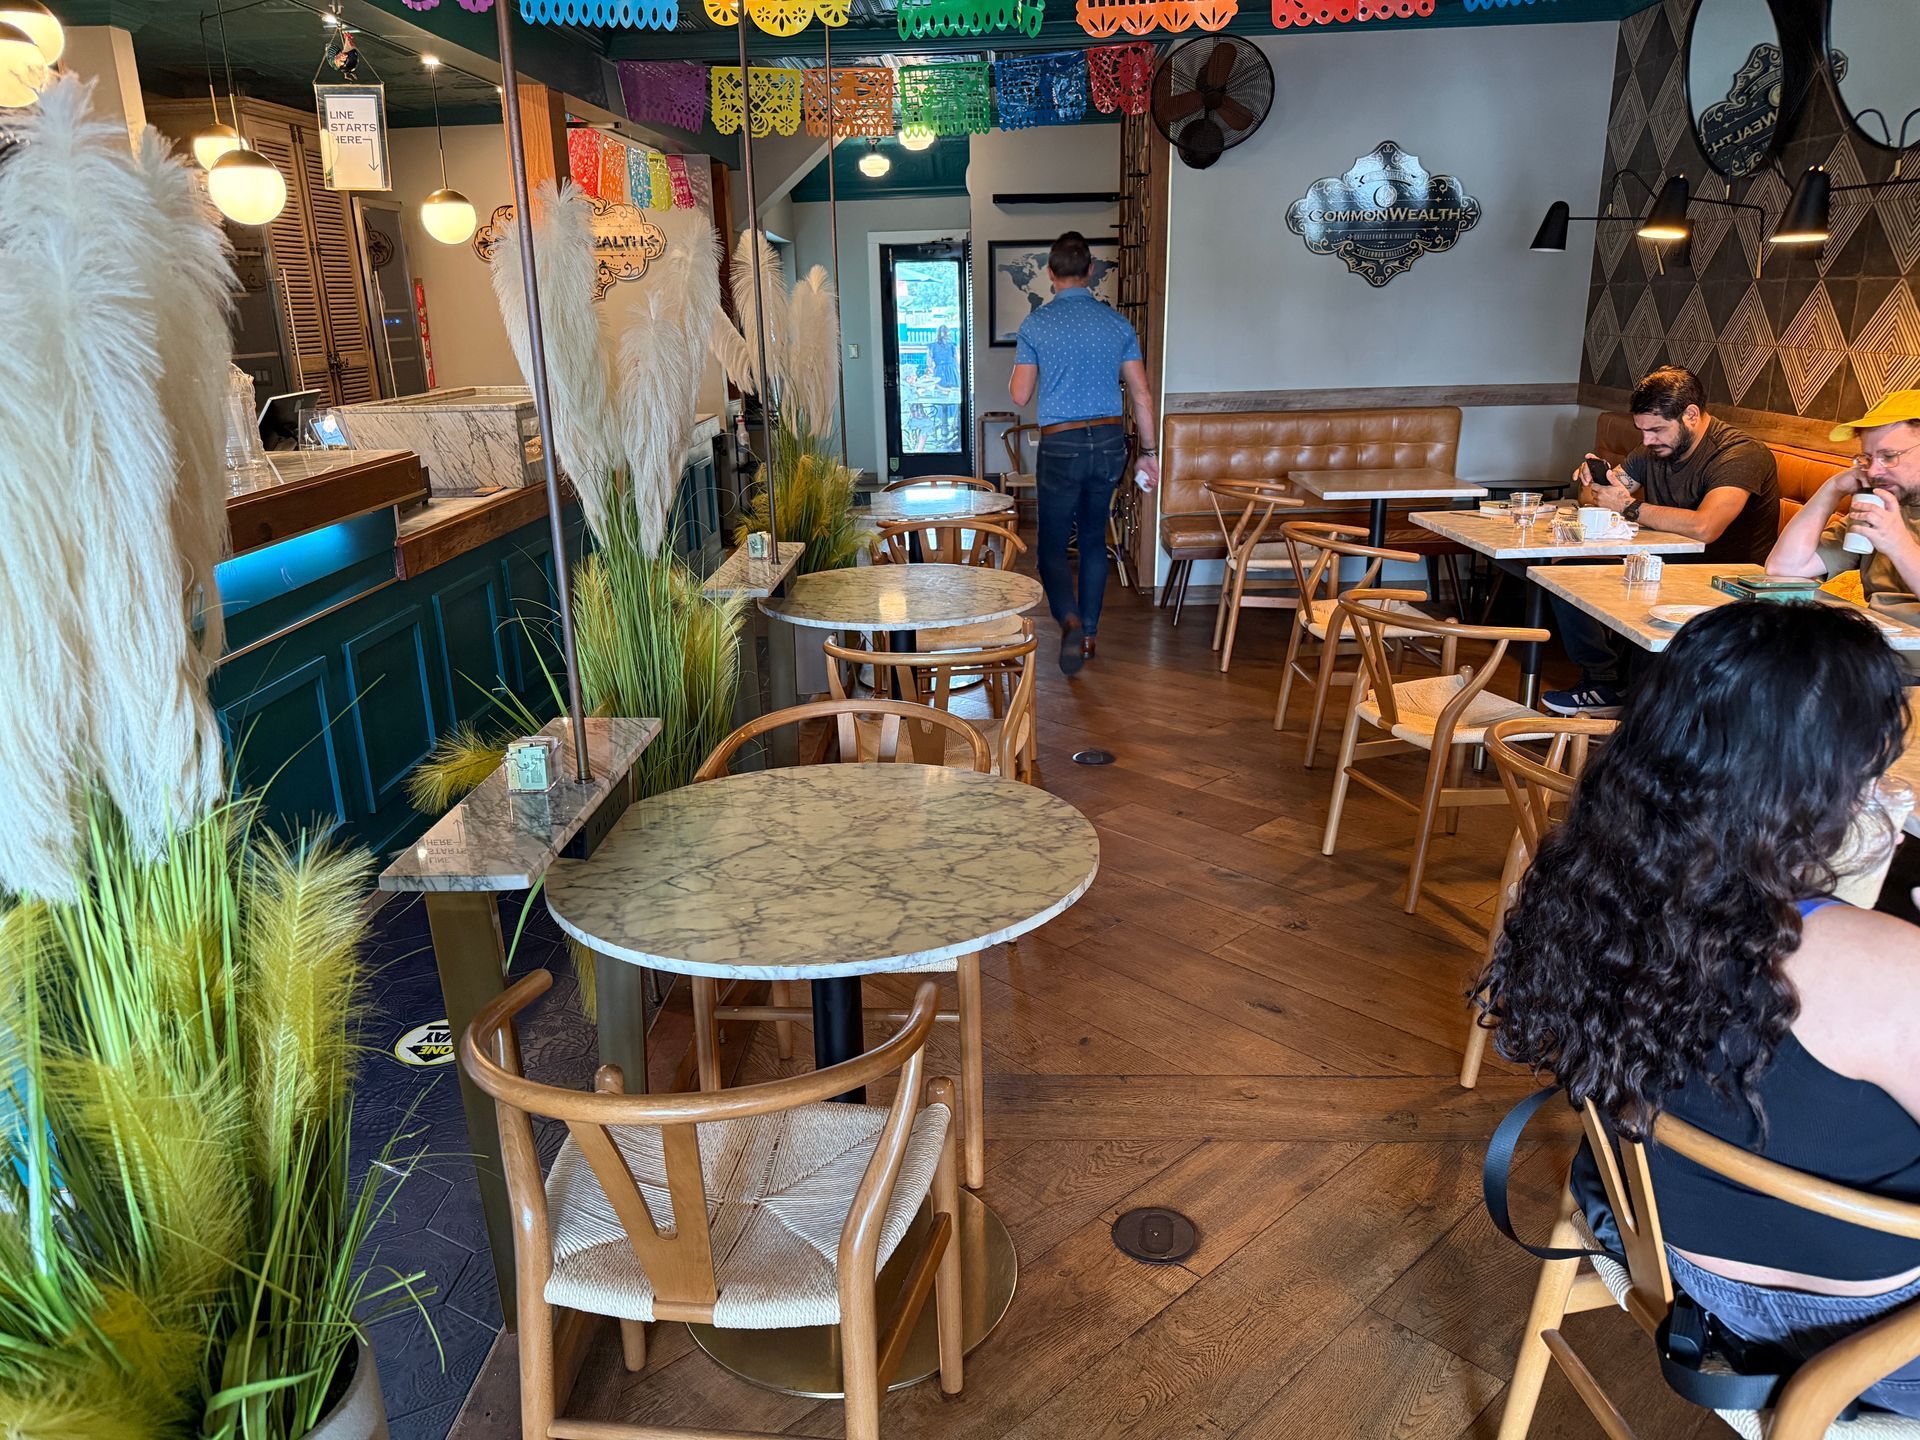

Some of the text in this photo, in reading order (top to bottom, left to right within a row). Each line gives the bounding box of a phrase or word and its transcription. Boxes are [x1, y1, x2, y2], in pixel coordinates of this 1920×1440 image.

[329, 111, 354, 120] LINE
[330, 123, 377, 132] STARTS
[417, 1031, 451, 1043] AY
[418, 1045, 453, 1054] ONE
